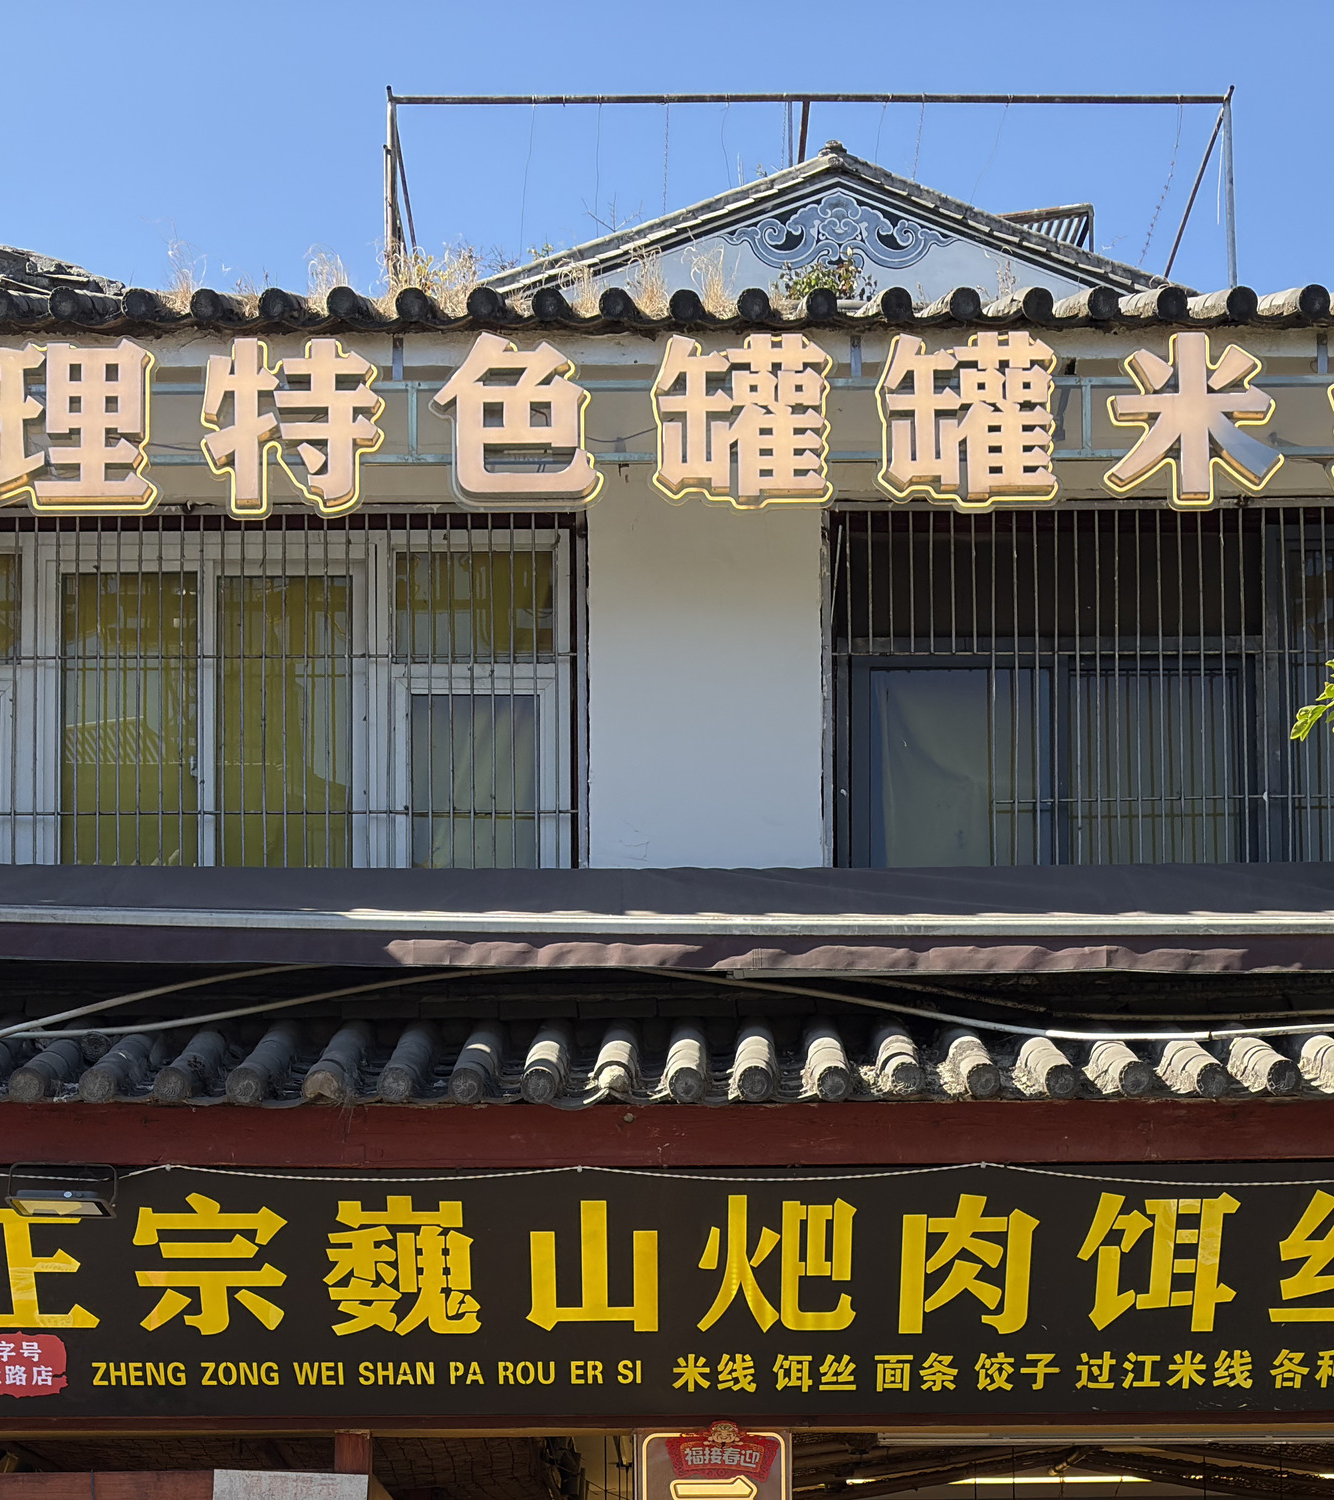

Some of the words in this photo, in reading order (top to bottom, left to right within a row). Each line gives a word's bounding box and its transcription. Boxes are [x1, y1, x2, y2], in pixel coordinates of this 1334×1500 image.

[91, 1360, 187, 1387] ZHENG
[201, 1360, 280, 1387] ZONG
[294, 1360, 344, 1387] WEI
[358, 1360, 435, 1387] SHAN
[449, 1360, 485, 1387] PA
[498, 1360, 556, 1387] ROU
[570, 1360, 604, 1387] ER
[617, 1360, 643, 1387] SI
[672, 1354, 758, 1392] 米线
[772, 1355, 858, 1392] 饵丝
[875, 1353, 959, 1392] 面条
[974, 1352, 1062, 1392] 饺子
[1075, 1349, 1254, 1391] 过江米线
